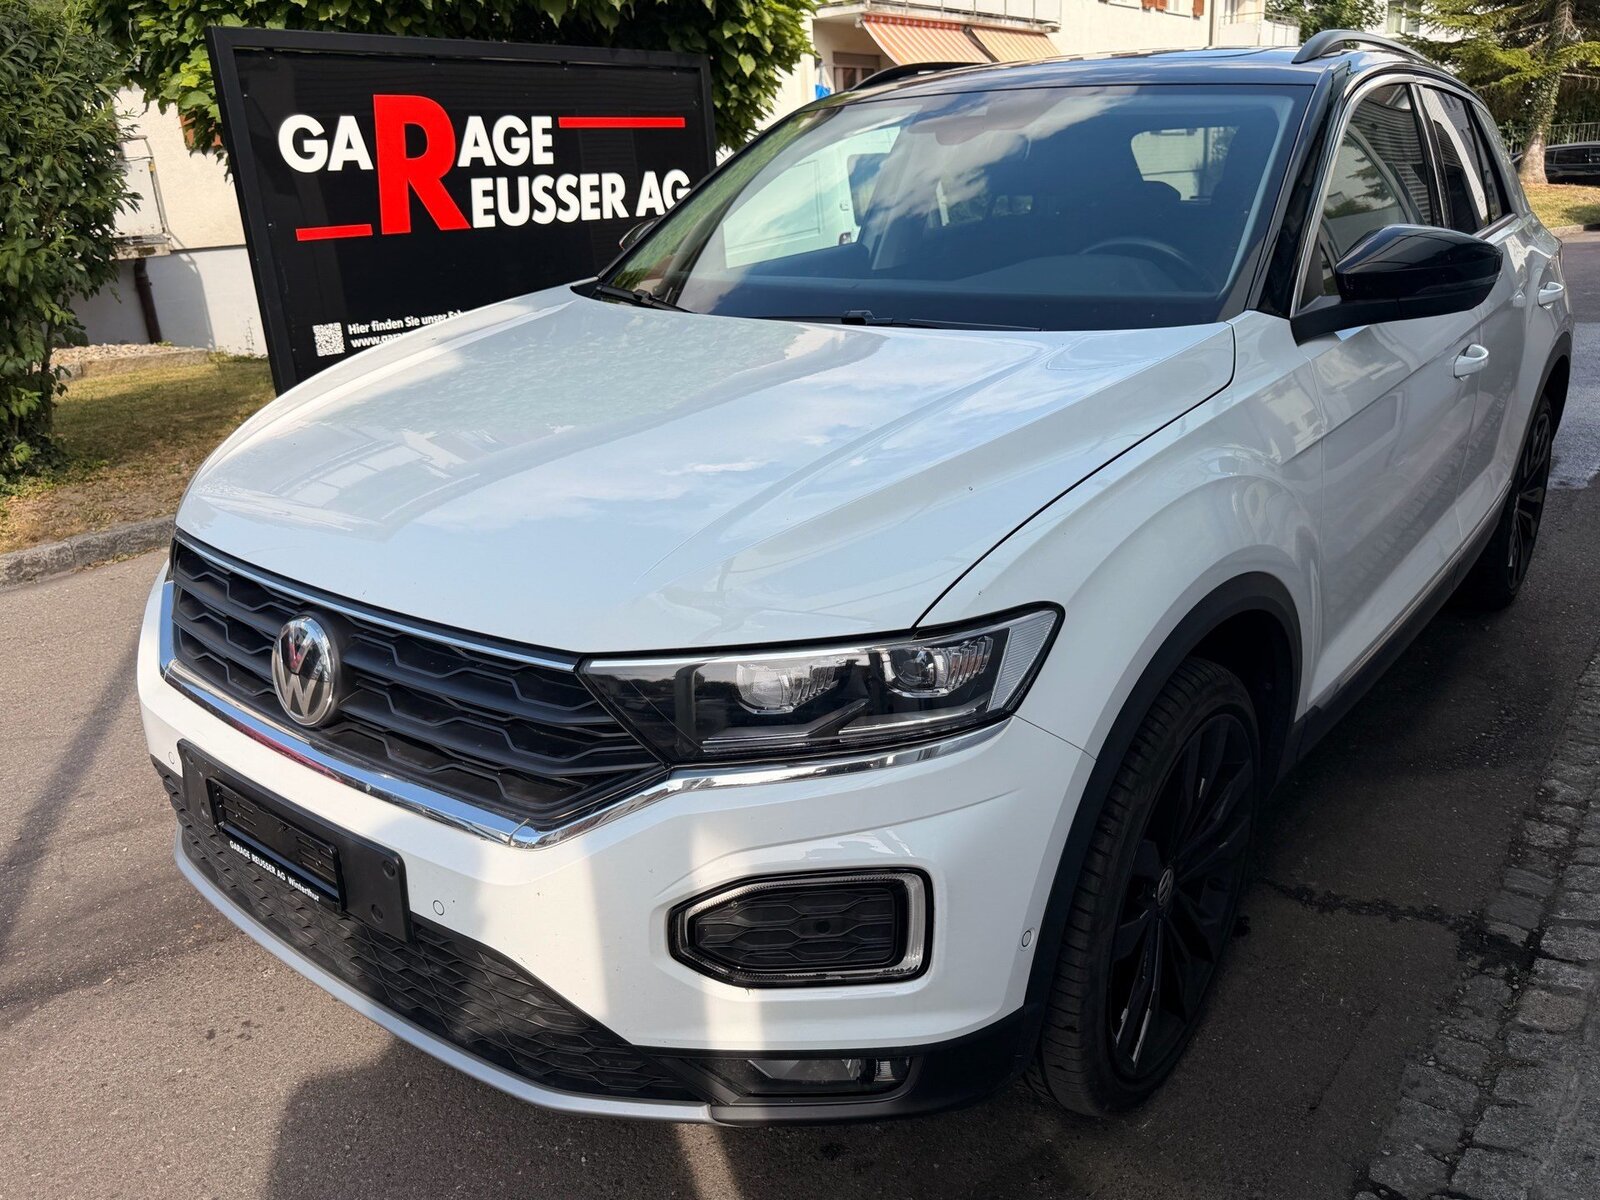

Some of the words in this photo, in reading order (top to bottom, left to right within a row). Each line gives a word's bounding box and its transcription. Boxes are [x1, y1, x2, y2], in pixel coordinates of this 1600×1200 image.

[278, 94, 554, 235] GARAGE
[635, 169, 691, 217] AG
[348, 322, 370, 335] Hier
[371, 318, 404, 332] finden
[404, 315, 420, 328] Sie
[229, 840, 251, 859] GARAGE
[251, 853, 277, 875] REUSSER
[276, 869, 286, 881] AG
